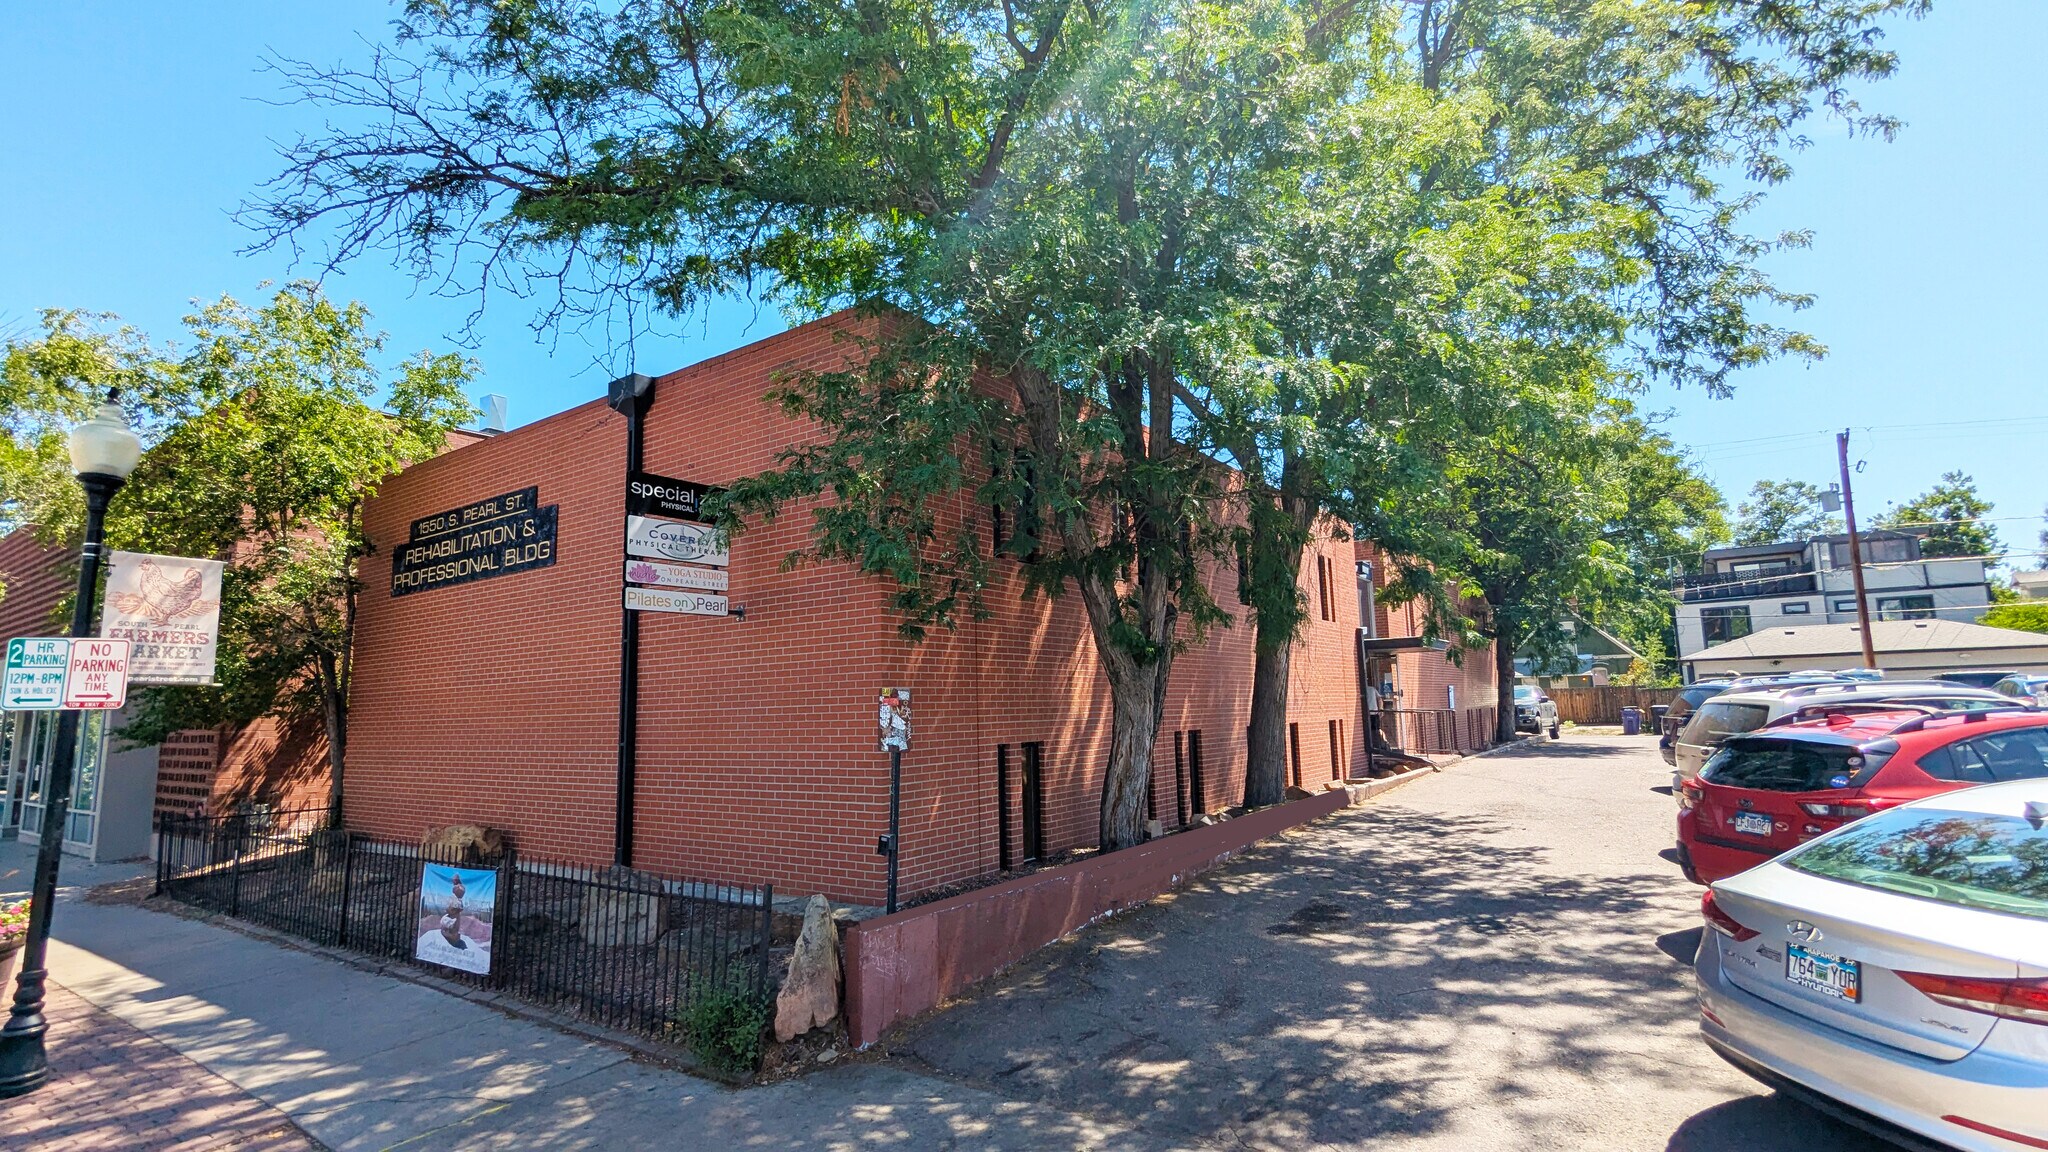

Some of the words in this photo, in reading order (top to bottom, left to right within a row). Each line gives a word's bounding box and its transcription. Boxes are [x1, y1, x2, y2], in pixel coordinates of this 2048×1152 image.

[661, 501, 694, 513] PHYSICAL
[418, 517, 445, 535] 1550
[448, 514, 459, 527] S.
[463, 501, 501, 523] PEARL
[505, 494, 525, 511] ST.
[405, 523, 517, 565] REHABILITATION
[522, 519, 536, 537] &
[629, 538, 680, 551] PHYSICAL
[393, 553, 499, 590] PROFESSIONAL
[504, 540, 550, 567] BLDG
[668, 567, 692, 578] YOGA
[693, 569, 723, 580] STUDIO
[627, 591, 672, 608] Pilates
[674, 600, 688, 608] on
[696, 597, 727, 612] Pearl
[118, 620, 148, 628] SOUTH
[109, 628, 210, 645] FARMERS
[10, 643, 23, 663] 2
[37, 642, 55, 653] HR
[90, 643, 112, 657] NO
[131, 644, 202, 660] ARKET
[23, 654, 66, 665] PARKING
[73, 659, 124, 672] PARKING
[9, 673, 62, 684] 12PM-8PM
[86, 673, 108, 682] ANY
[85, 682, 108, 691] TIME
[1790, 954, 1814, 977] 764
